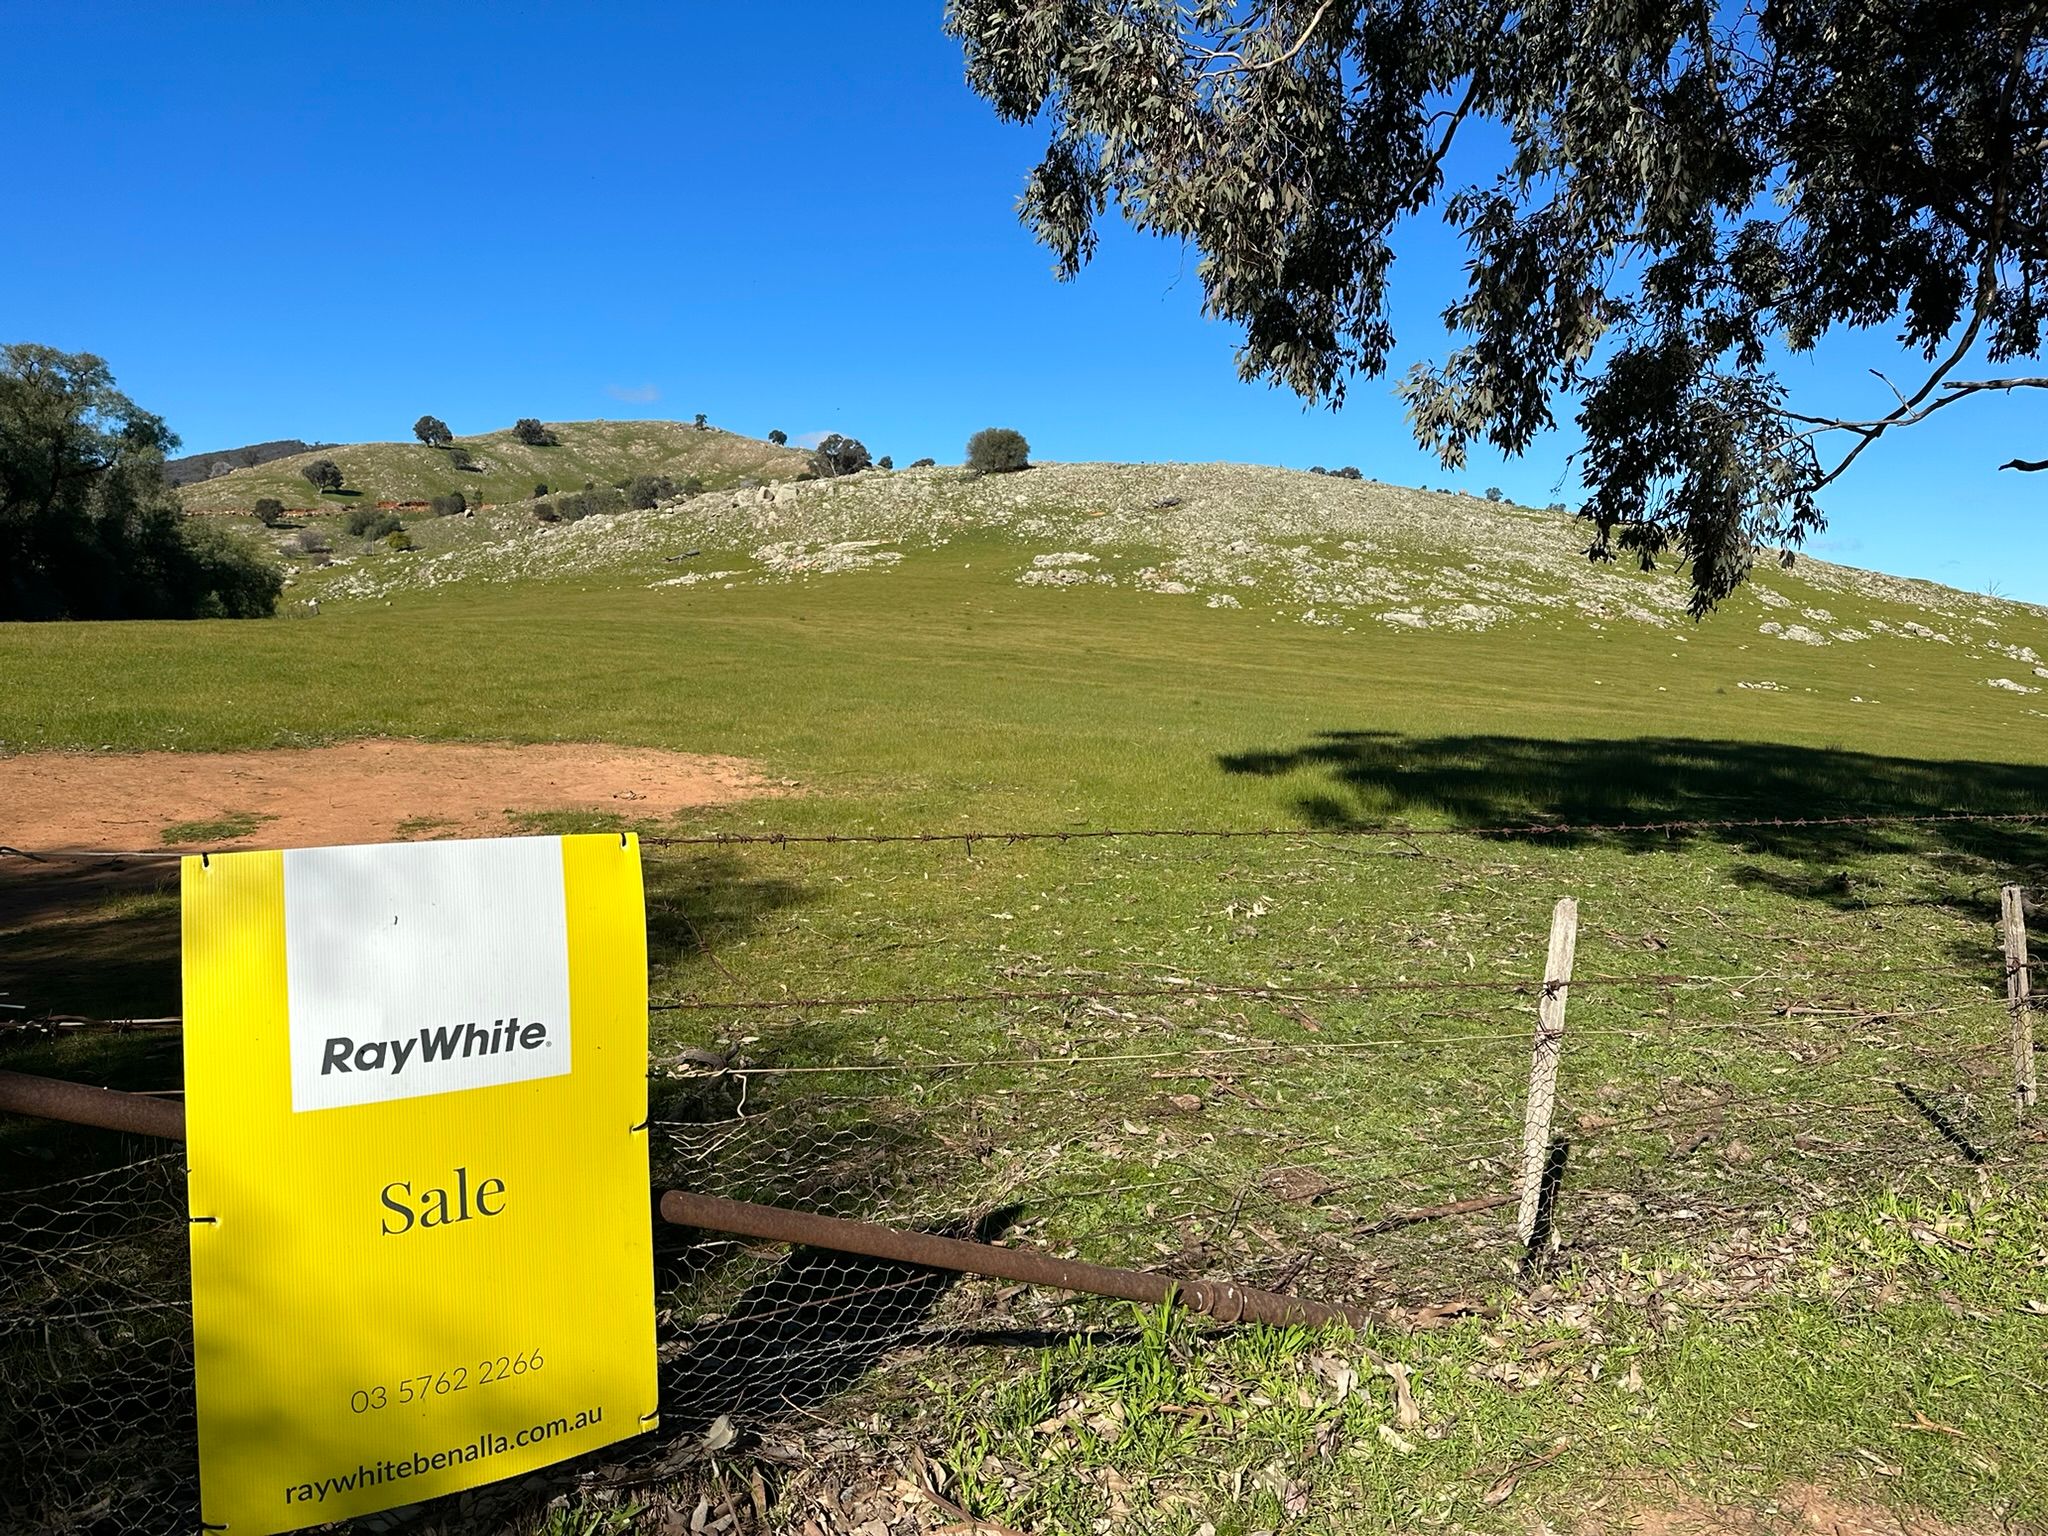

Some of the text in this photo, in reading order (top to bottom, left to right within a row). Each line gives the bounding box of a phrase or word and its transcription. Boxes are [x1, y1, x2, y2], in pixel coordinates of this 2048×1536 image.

[381, 1166, 506, 1237] Sale
[350, 1347, 545, 1414] 03 5762 2266
[285, 1406, 603, 1505] raywhitebenalla.com.au
